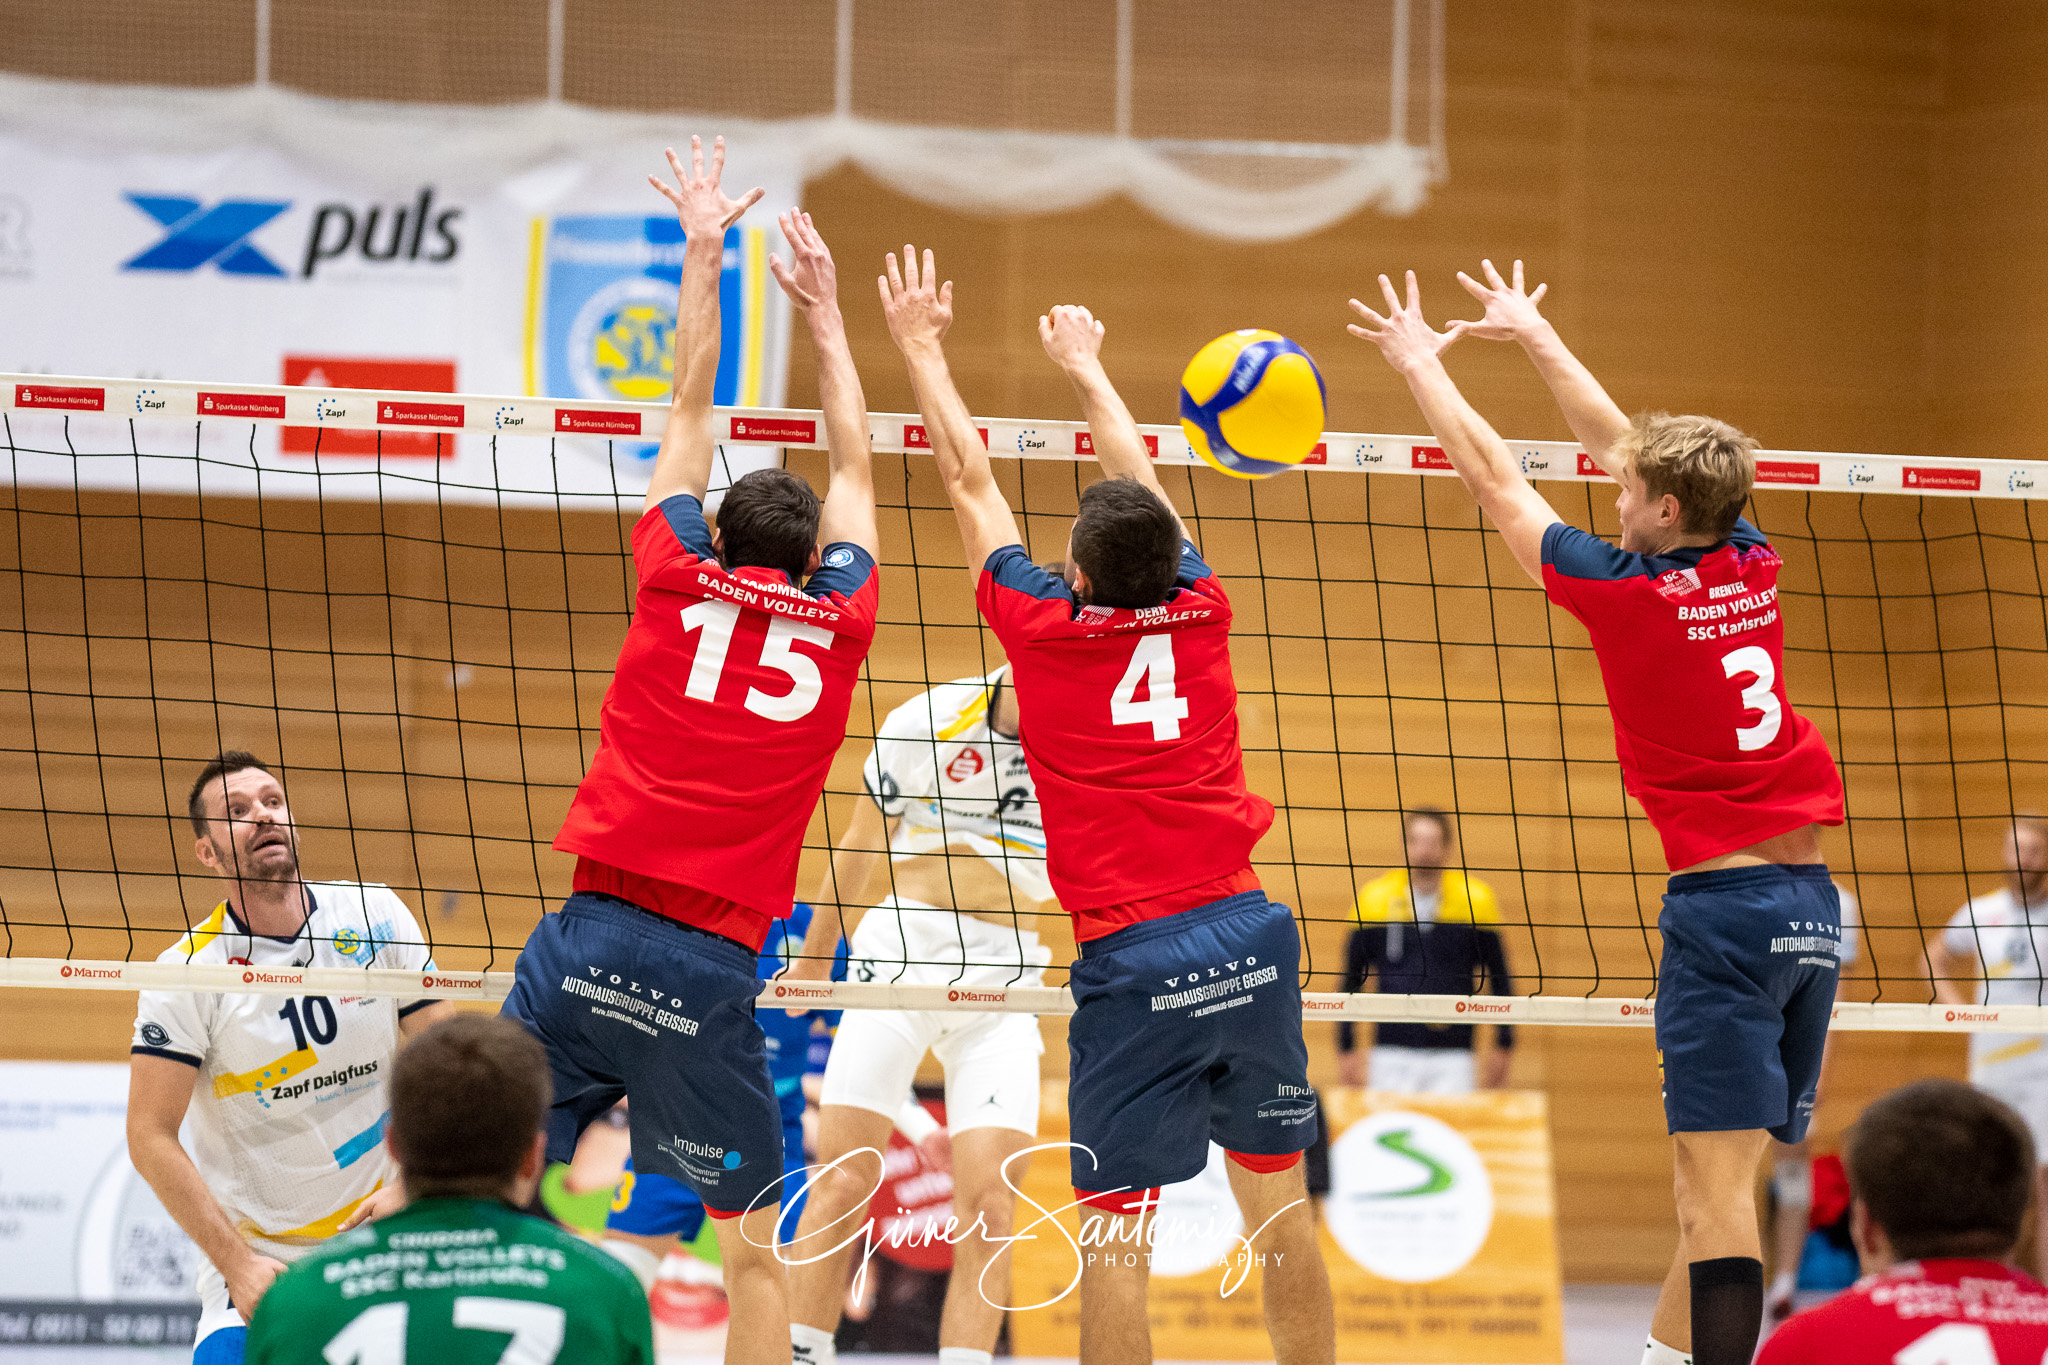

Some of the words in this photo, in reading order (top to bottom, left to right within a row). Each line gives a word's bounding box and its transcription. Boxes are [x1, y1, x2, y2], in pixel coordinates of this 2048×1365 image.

[33, 394, 66, 405] Sparkasse
[67, 395, 99, 406] Nürnberg
[144, 399, 166, 410] Zapf
[215, 402, 248, 413] Sparkasse
[249, 404, 280, 415] Nürnberg
[325, 408, 346, 419] Zapf
[395, 412, 428, 422] Sparkasse
[428, 413, 459, 424] Nürnberg
[503, 416, 525, 427] Zapf
[572, 419, 605, 430] Sparkasse
[606, 421, 636, 431] Nürnberg
[748, 427, 780, 437] Sparkasse
[780, 428, 810, 439] Nürnberg
[1025, 439, 1046, 450] Zapf
[1363, 453, 1383, 464] Zapf
[1529, 460, 1549, 471] Zapf
[1855, 473, 1875, 484] Zapf
[697, 572, 759, 605] BADEN
[763, 596, 840, 622] VOLLEYS
[1708, 581, 1748, 600] BRENTEL
[1142, 609, 1213, 627] VOLLEYS
[1677, 603, 1728, 621] BADEN
[1687, 625, 1717, 641] SSC
[680, 600, 823, 722] 15
[1110, 633, 1189, 742] 4
[1720, 645, 1782, 752] 3
[1788, 921, 1841, 937] VOLVO
[73, 966, 122, 979] Marmot
[255, 971, 303, 984] Marmot
[1164, 956, 1257, 989] VOLVO
[435, 977, 483, 989] Marmot
[588, 965, 683, 1009] VOLVO
[1151, 976, 1243, 1012] AUTOHAUSGRUPPE
[1242, 965, 1278, 990] GEISSER
[787, 986, 833, 998] Marmot
[960, 990, 1006, 1003] Marmot
[561, 975, 656, 1021] AUTOHAUSGRUPPE
[655, 1008, 699, 1037] GEISSER
[1467, 1002, 1511, 1014] Marmot
[279, 995, 338, 1052] 10
[1957, 1012, 1999, 1022] Marmot
[271, 1079, 310, 1102] Zapf
[313, 1058, 379, 1091] Daigfuss
[674, 1134, 724, 1159] Impulse
